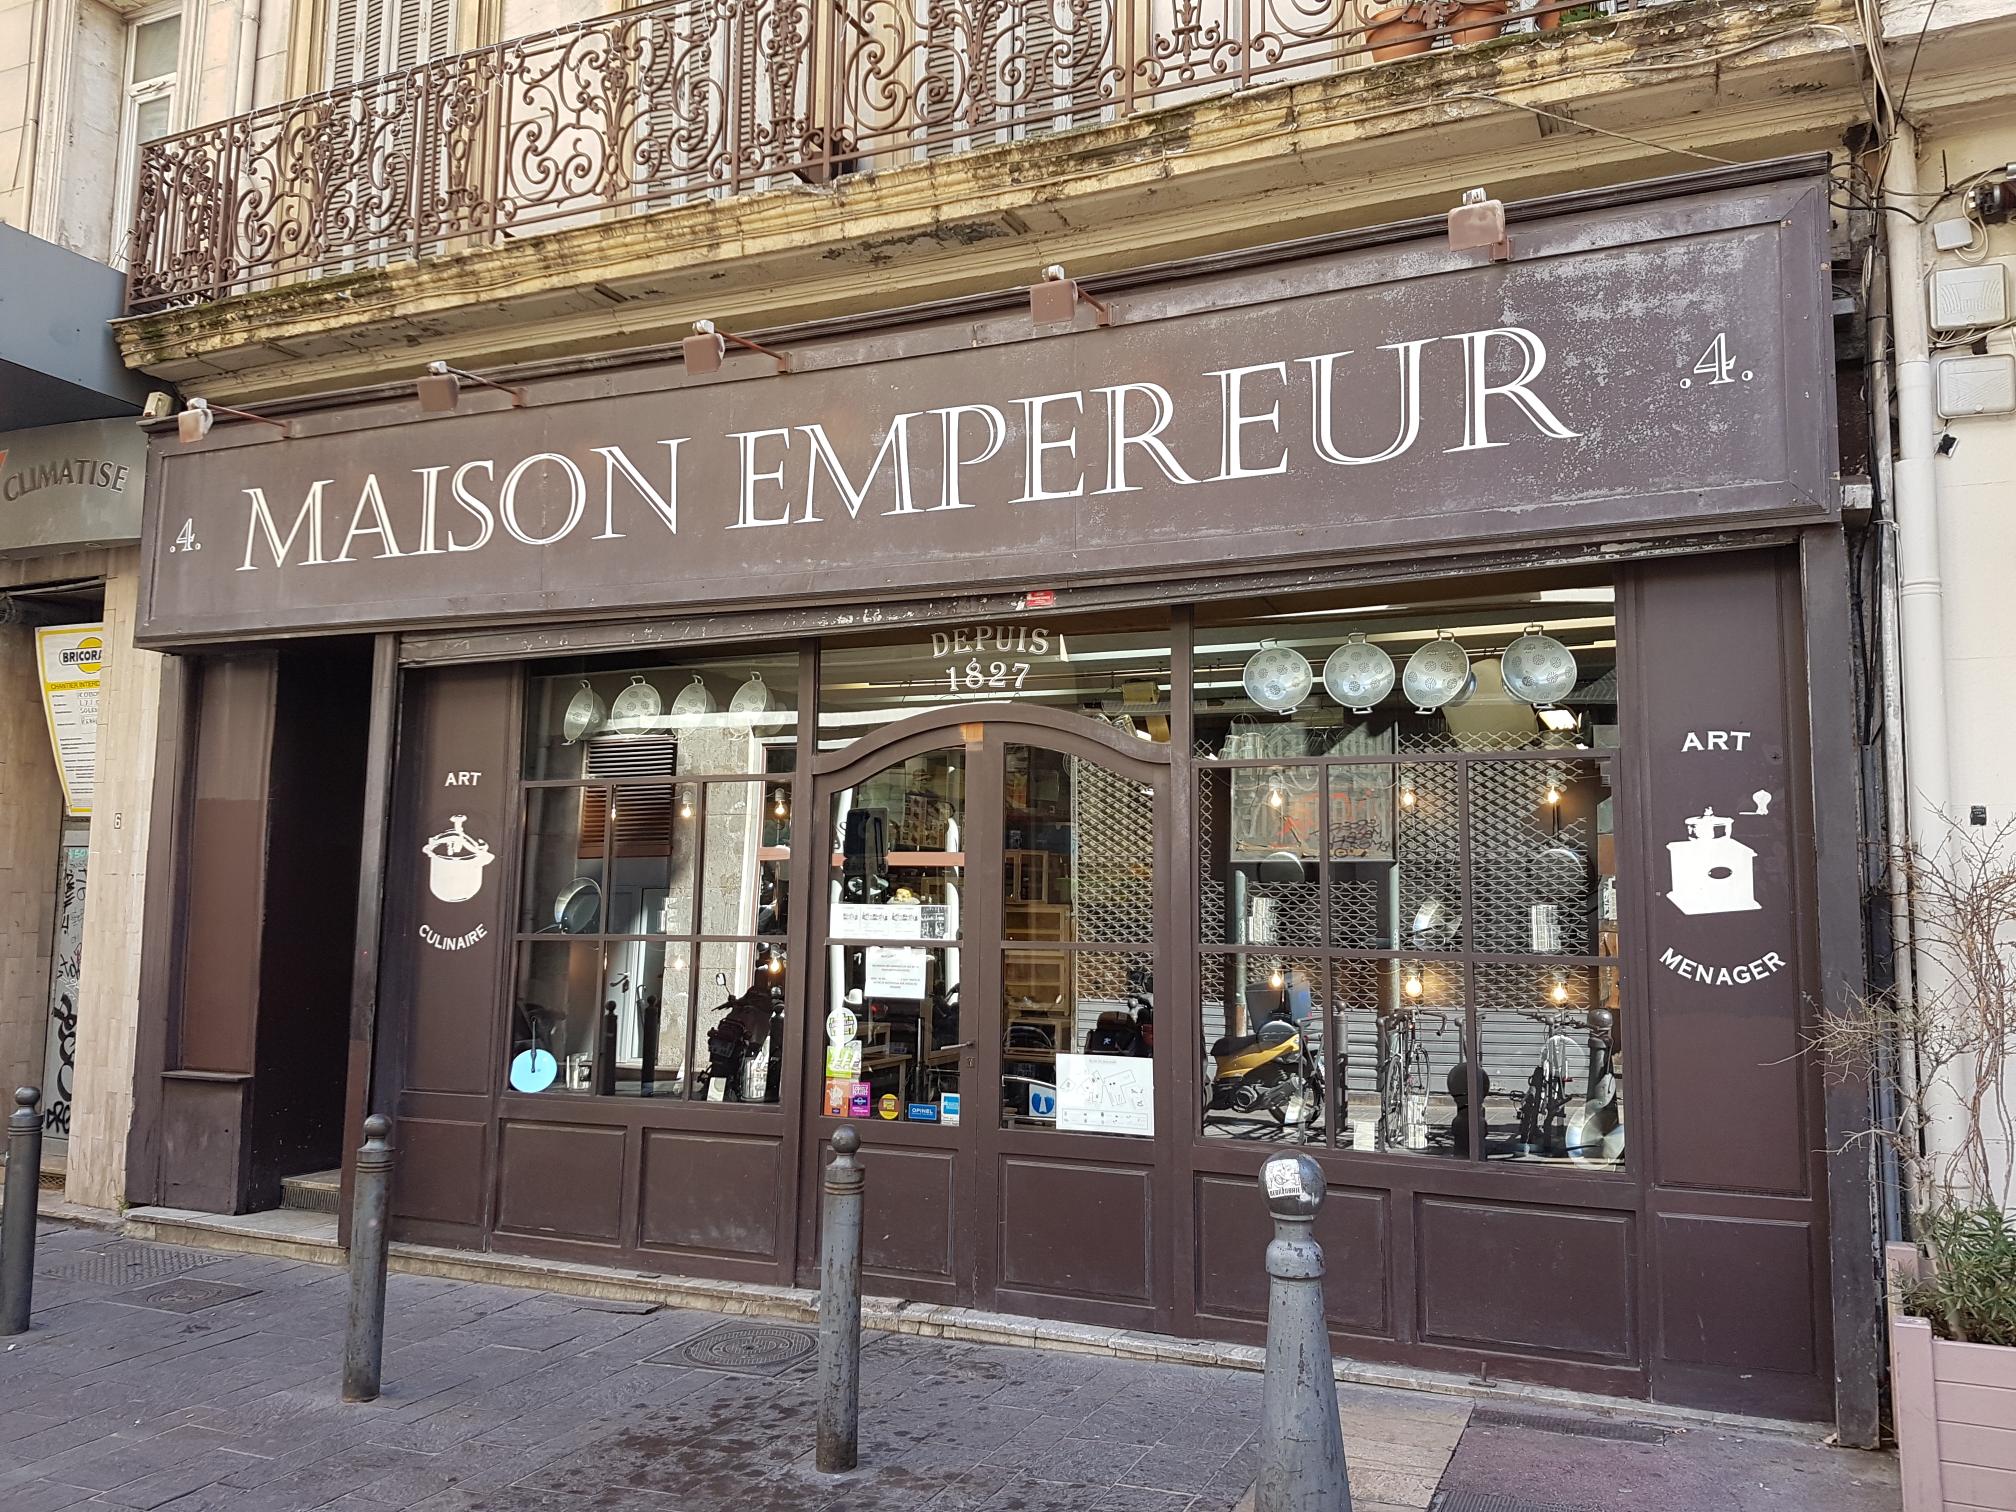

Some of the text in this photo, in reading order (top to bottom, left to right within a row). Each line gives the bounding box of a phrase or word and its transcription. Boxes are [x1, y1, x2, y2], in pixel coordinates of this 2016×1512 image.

[235, 437, 692, 571] MAISON
[724, 327, 1584, 530] EMPEREUR
[3, 457, 131, 502] CLIMATISE
[930, 625, 1049, 658] DEPUIS
[945, 657, 1031, 692] 1827
[1681, 730, 1752, 753] ART
[445, 771, 482, 787] ART
[114, 813, 121, 828] 6
[418, 923, 489, 951] CULINAIRE
[1659, 946, 1787, 986] MENAGER
